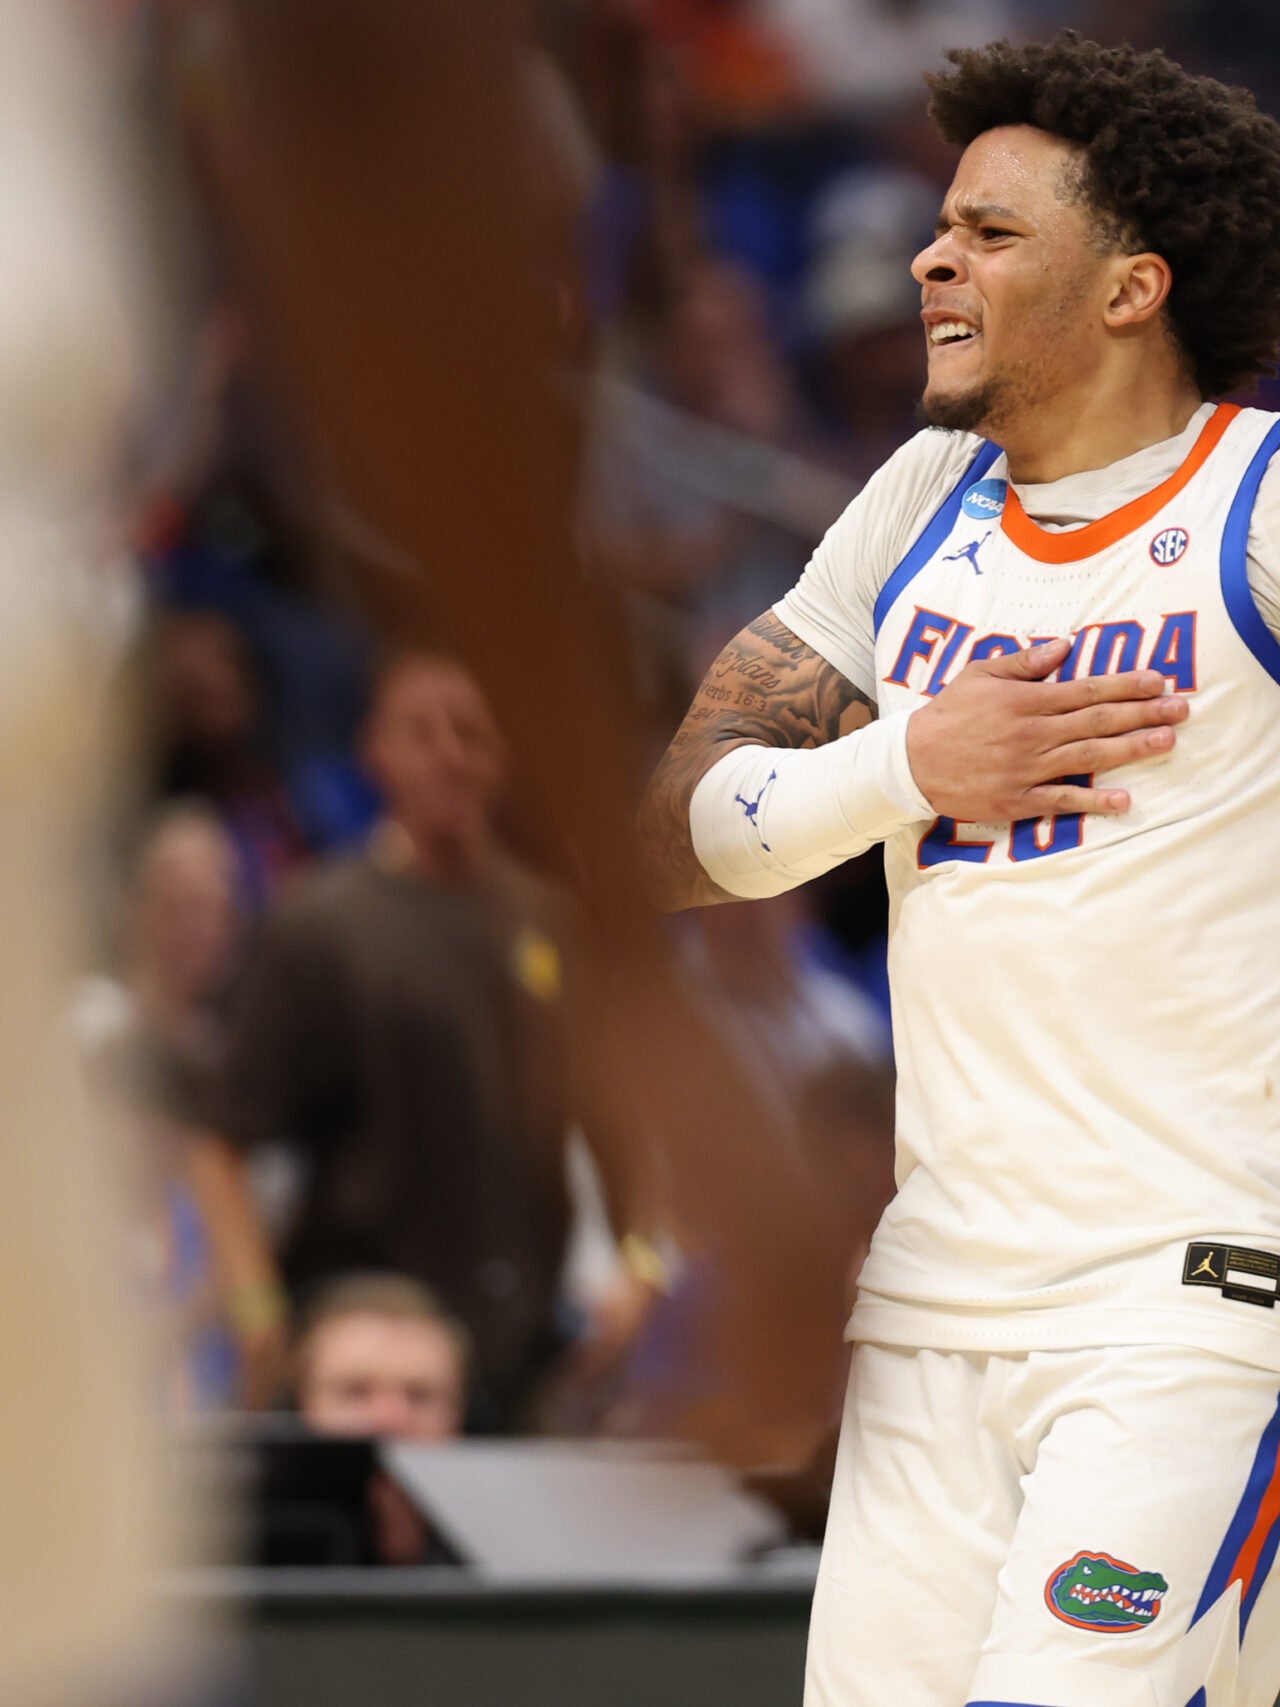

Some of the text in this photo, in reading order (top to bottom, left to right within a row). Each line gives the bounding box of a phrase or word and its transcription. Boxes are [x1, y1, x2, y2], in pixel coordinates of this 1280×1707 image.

[966, 491, 1004, 514] NCAA
[1153, 528, 1187, 564] SEC
[882, 604, 1197, 698] FLIDA
